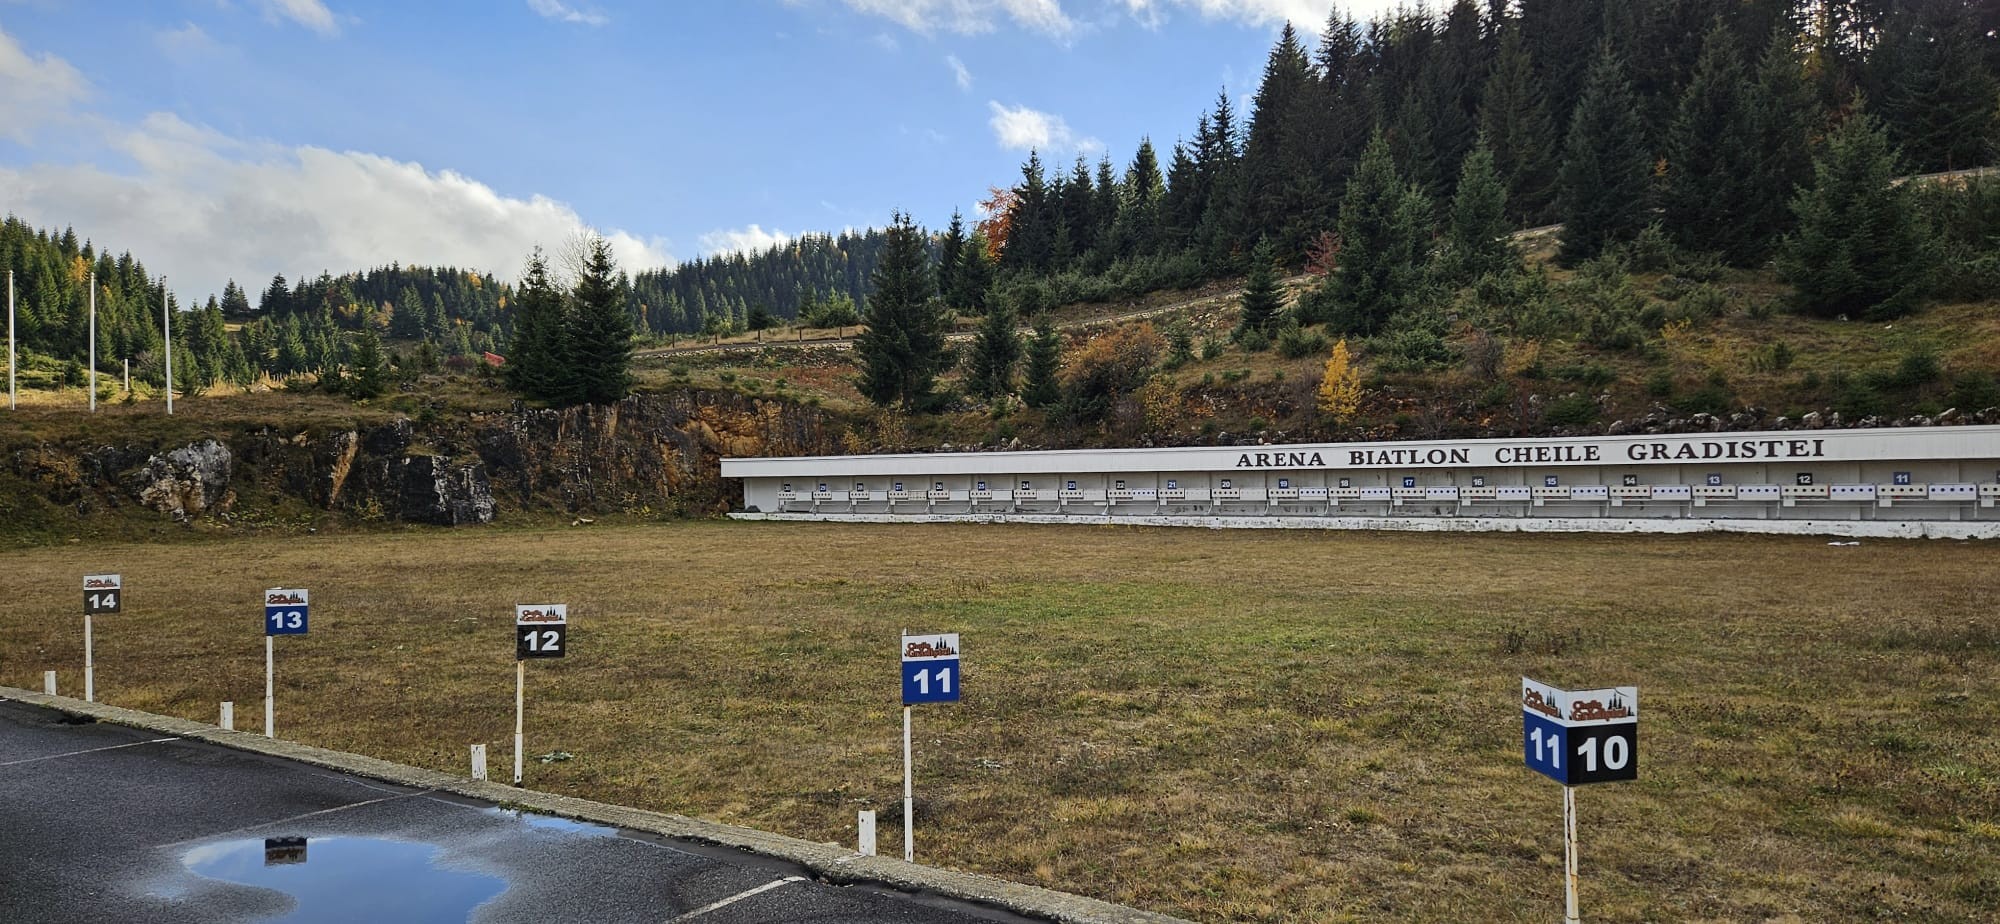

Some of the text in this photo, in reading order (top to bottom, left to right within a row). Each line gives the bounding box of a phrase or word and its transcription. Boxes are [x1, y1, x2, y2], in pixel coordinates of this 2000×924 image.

[1236, 439, 1825, 467] ARENA BIATLON CHEILE GRADISTEI
[1799, 475, 1811, 483] 12
[1896, 474, 1908, 483] 11
[89, 594, 116, 608] 14
[272, 611, 302, 628] 13
[524, 631, 559, 651] 12
[913, 667, 950, 694] 11
[1530, 727, 1559, 769] 11
[1577, 735, 1629, 772] 10
